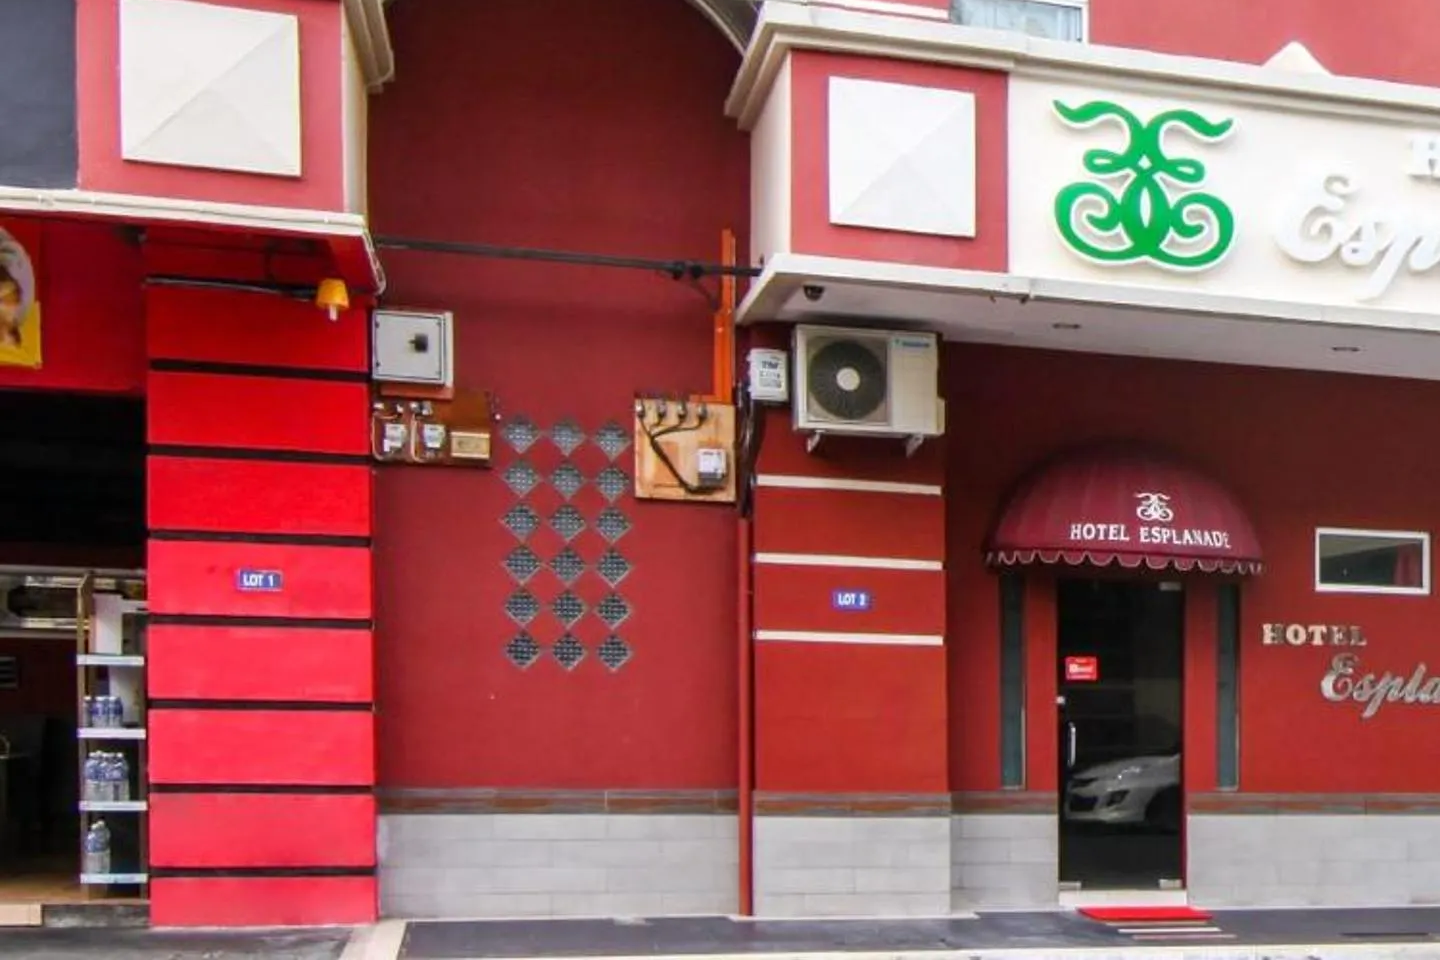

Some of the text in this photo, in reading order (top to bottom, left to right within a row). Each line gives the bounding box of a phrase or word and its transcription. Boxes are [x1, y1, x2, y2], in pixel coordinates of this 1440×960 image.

[1070, 523, 1231, 548] HOTEL ESPLANADE
[243, 573, 274, 587] LOT 1
[838, 592, 855, 606] LOT
[1262, 623, 1367, 646] HOTEL
